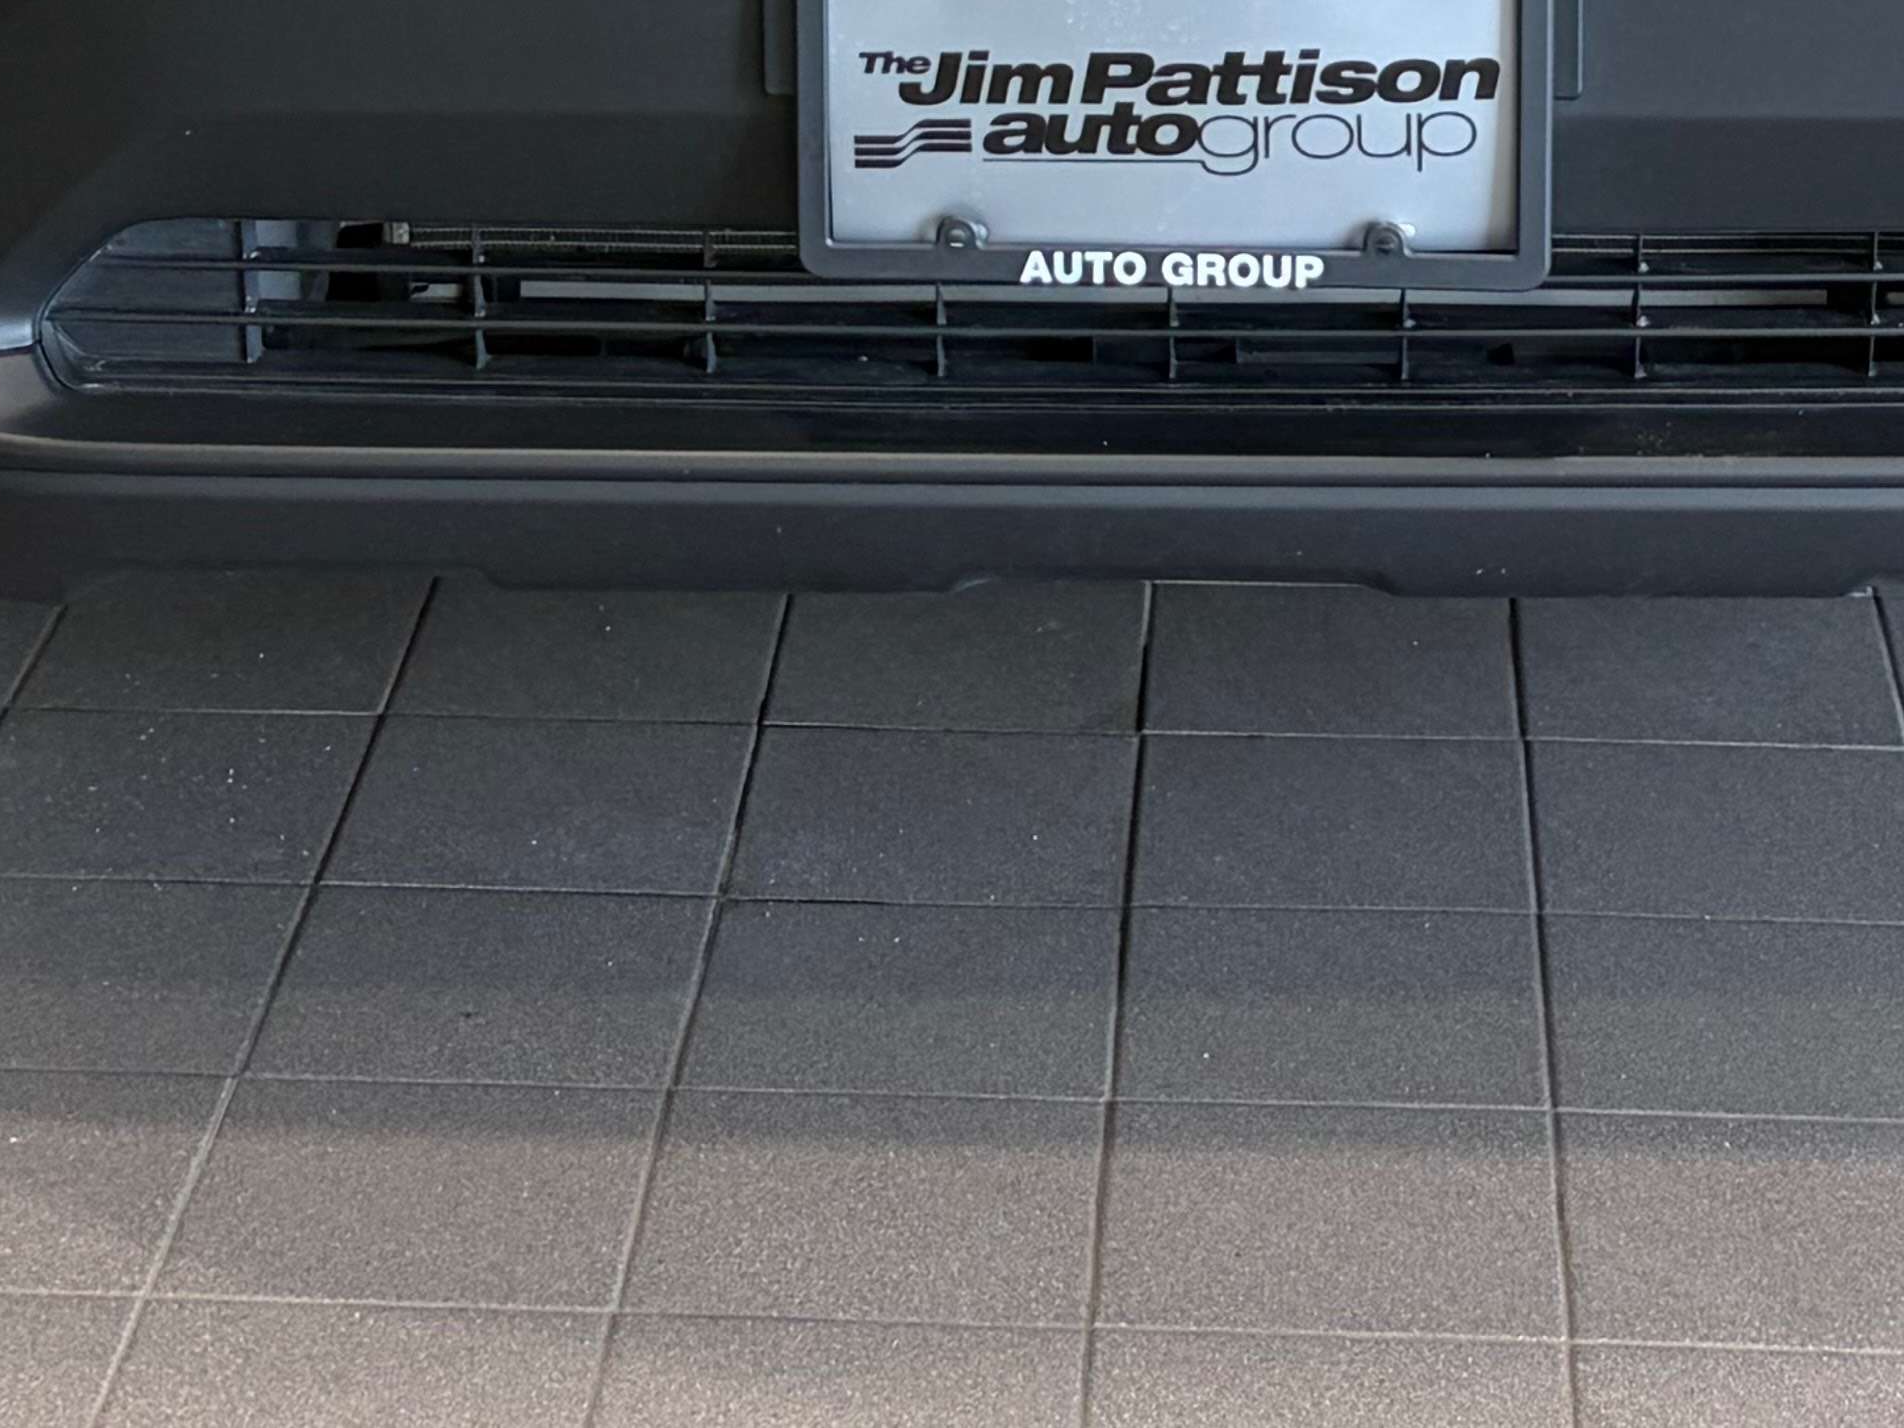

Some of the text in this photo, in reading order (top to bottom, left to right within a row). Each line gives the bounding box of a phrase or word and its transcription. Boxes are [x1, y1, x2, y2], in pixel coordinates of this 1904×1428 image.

[858, 50, 932, 76] The
[1019, 250, 1325, 290] AUTO GROUP
